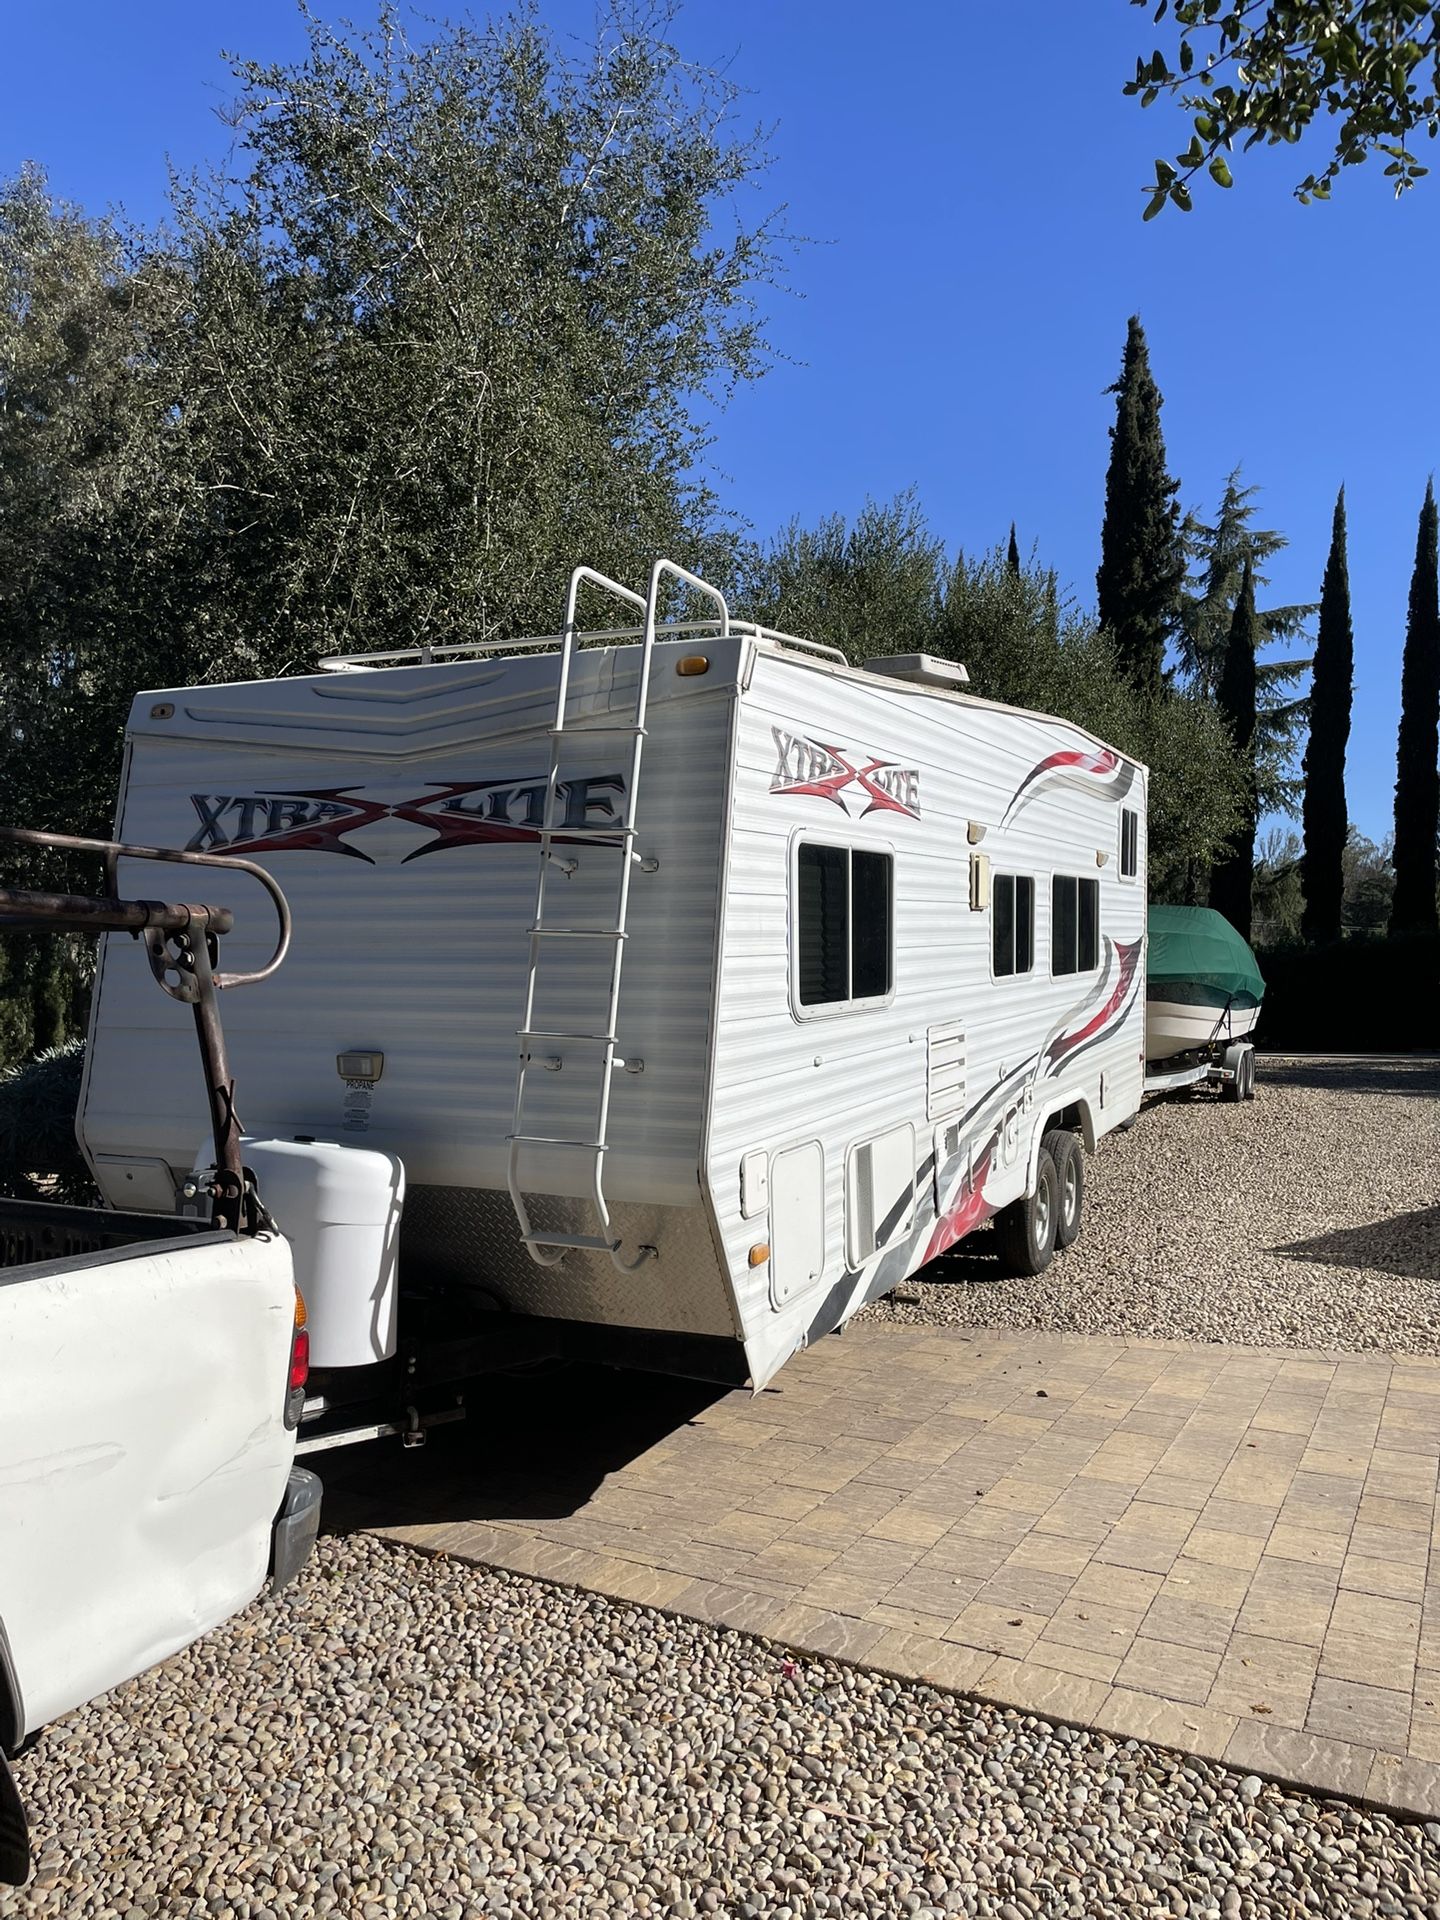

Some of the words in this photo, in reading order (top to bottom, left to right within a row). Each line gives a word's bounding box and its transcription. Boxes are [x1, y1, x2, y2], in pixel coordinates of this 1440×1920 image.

[769, 724, 847, 791] XTRA
[870, 769, 922, 816] LITE
[184, 794, 355, 852] XTRA
[438, 773, 627, 829] LITE
[345, 1079, 375, 1091] PROPANE
